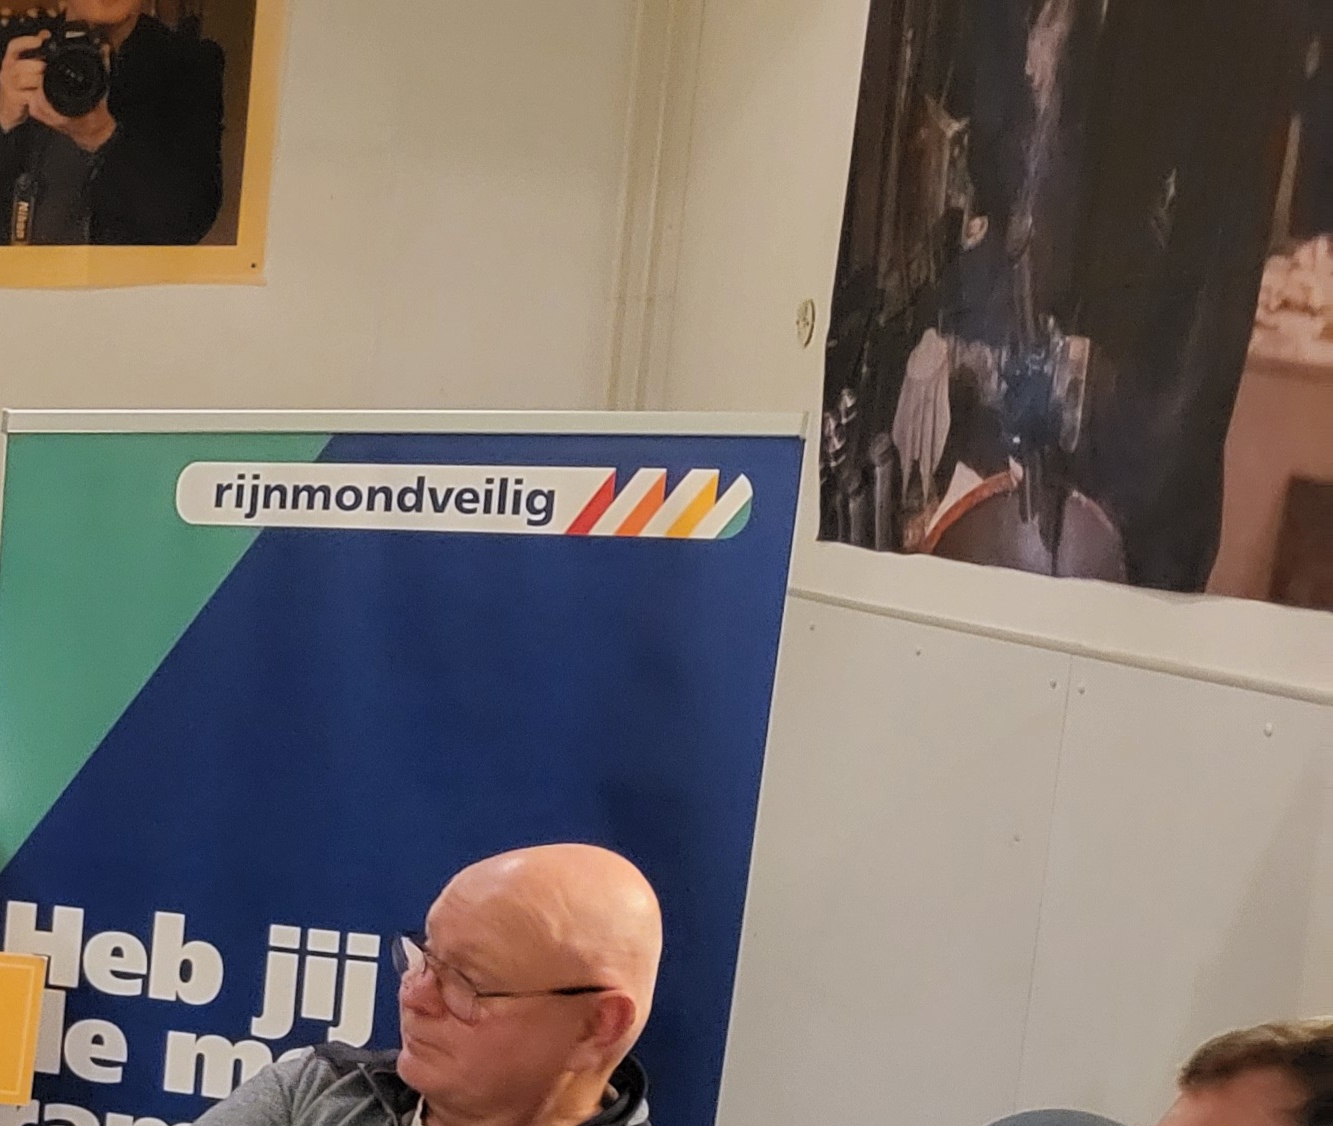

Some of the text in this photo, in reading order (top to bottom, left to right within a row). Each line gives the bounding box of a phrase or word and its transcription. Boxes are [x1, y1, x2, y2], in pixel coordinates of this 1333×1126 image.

[214, 474, 555, 526] rijnmondveilig
[3, 900, 381, 1048] Heb jij
